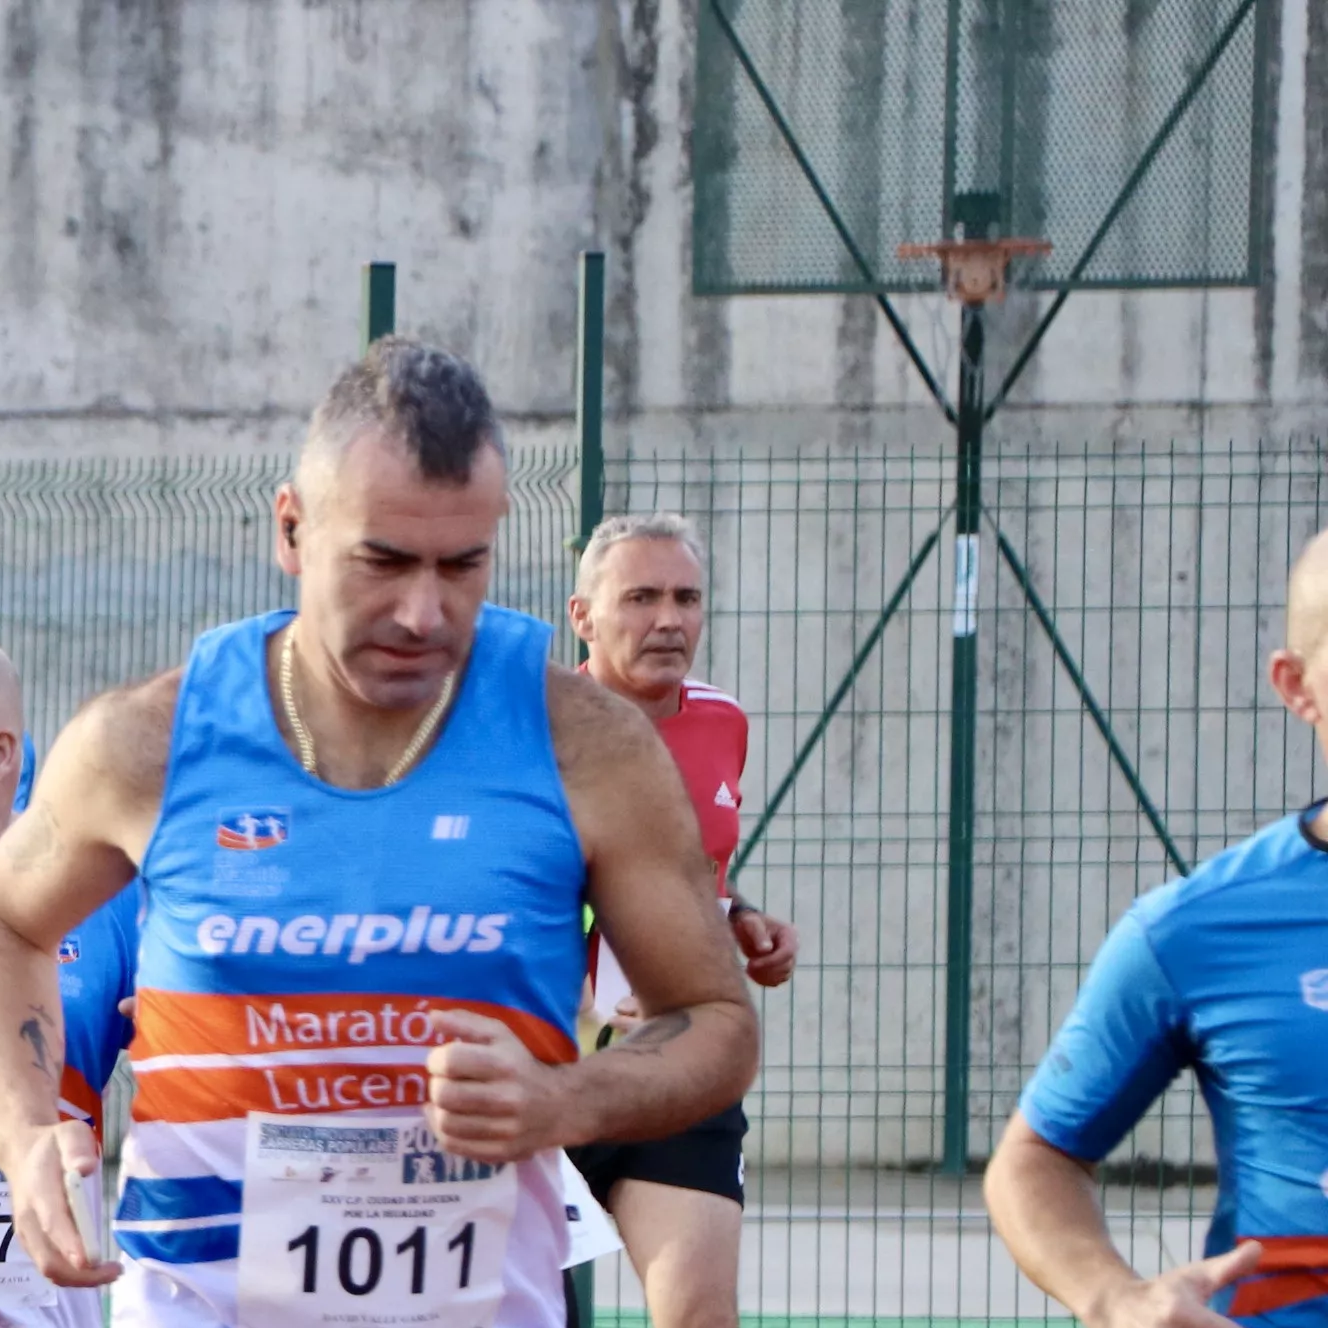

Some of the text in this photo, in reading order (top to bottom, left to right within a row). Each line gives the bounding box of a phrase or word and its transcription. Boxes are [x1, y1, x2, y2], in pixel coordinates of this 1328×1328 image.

[197, 906, 508, 964] enerplus
[263, 1069, 426, 1111] Lucen
[287, 1222, 475, 1295] 1011
